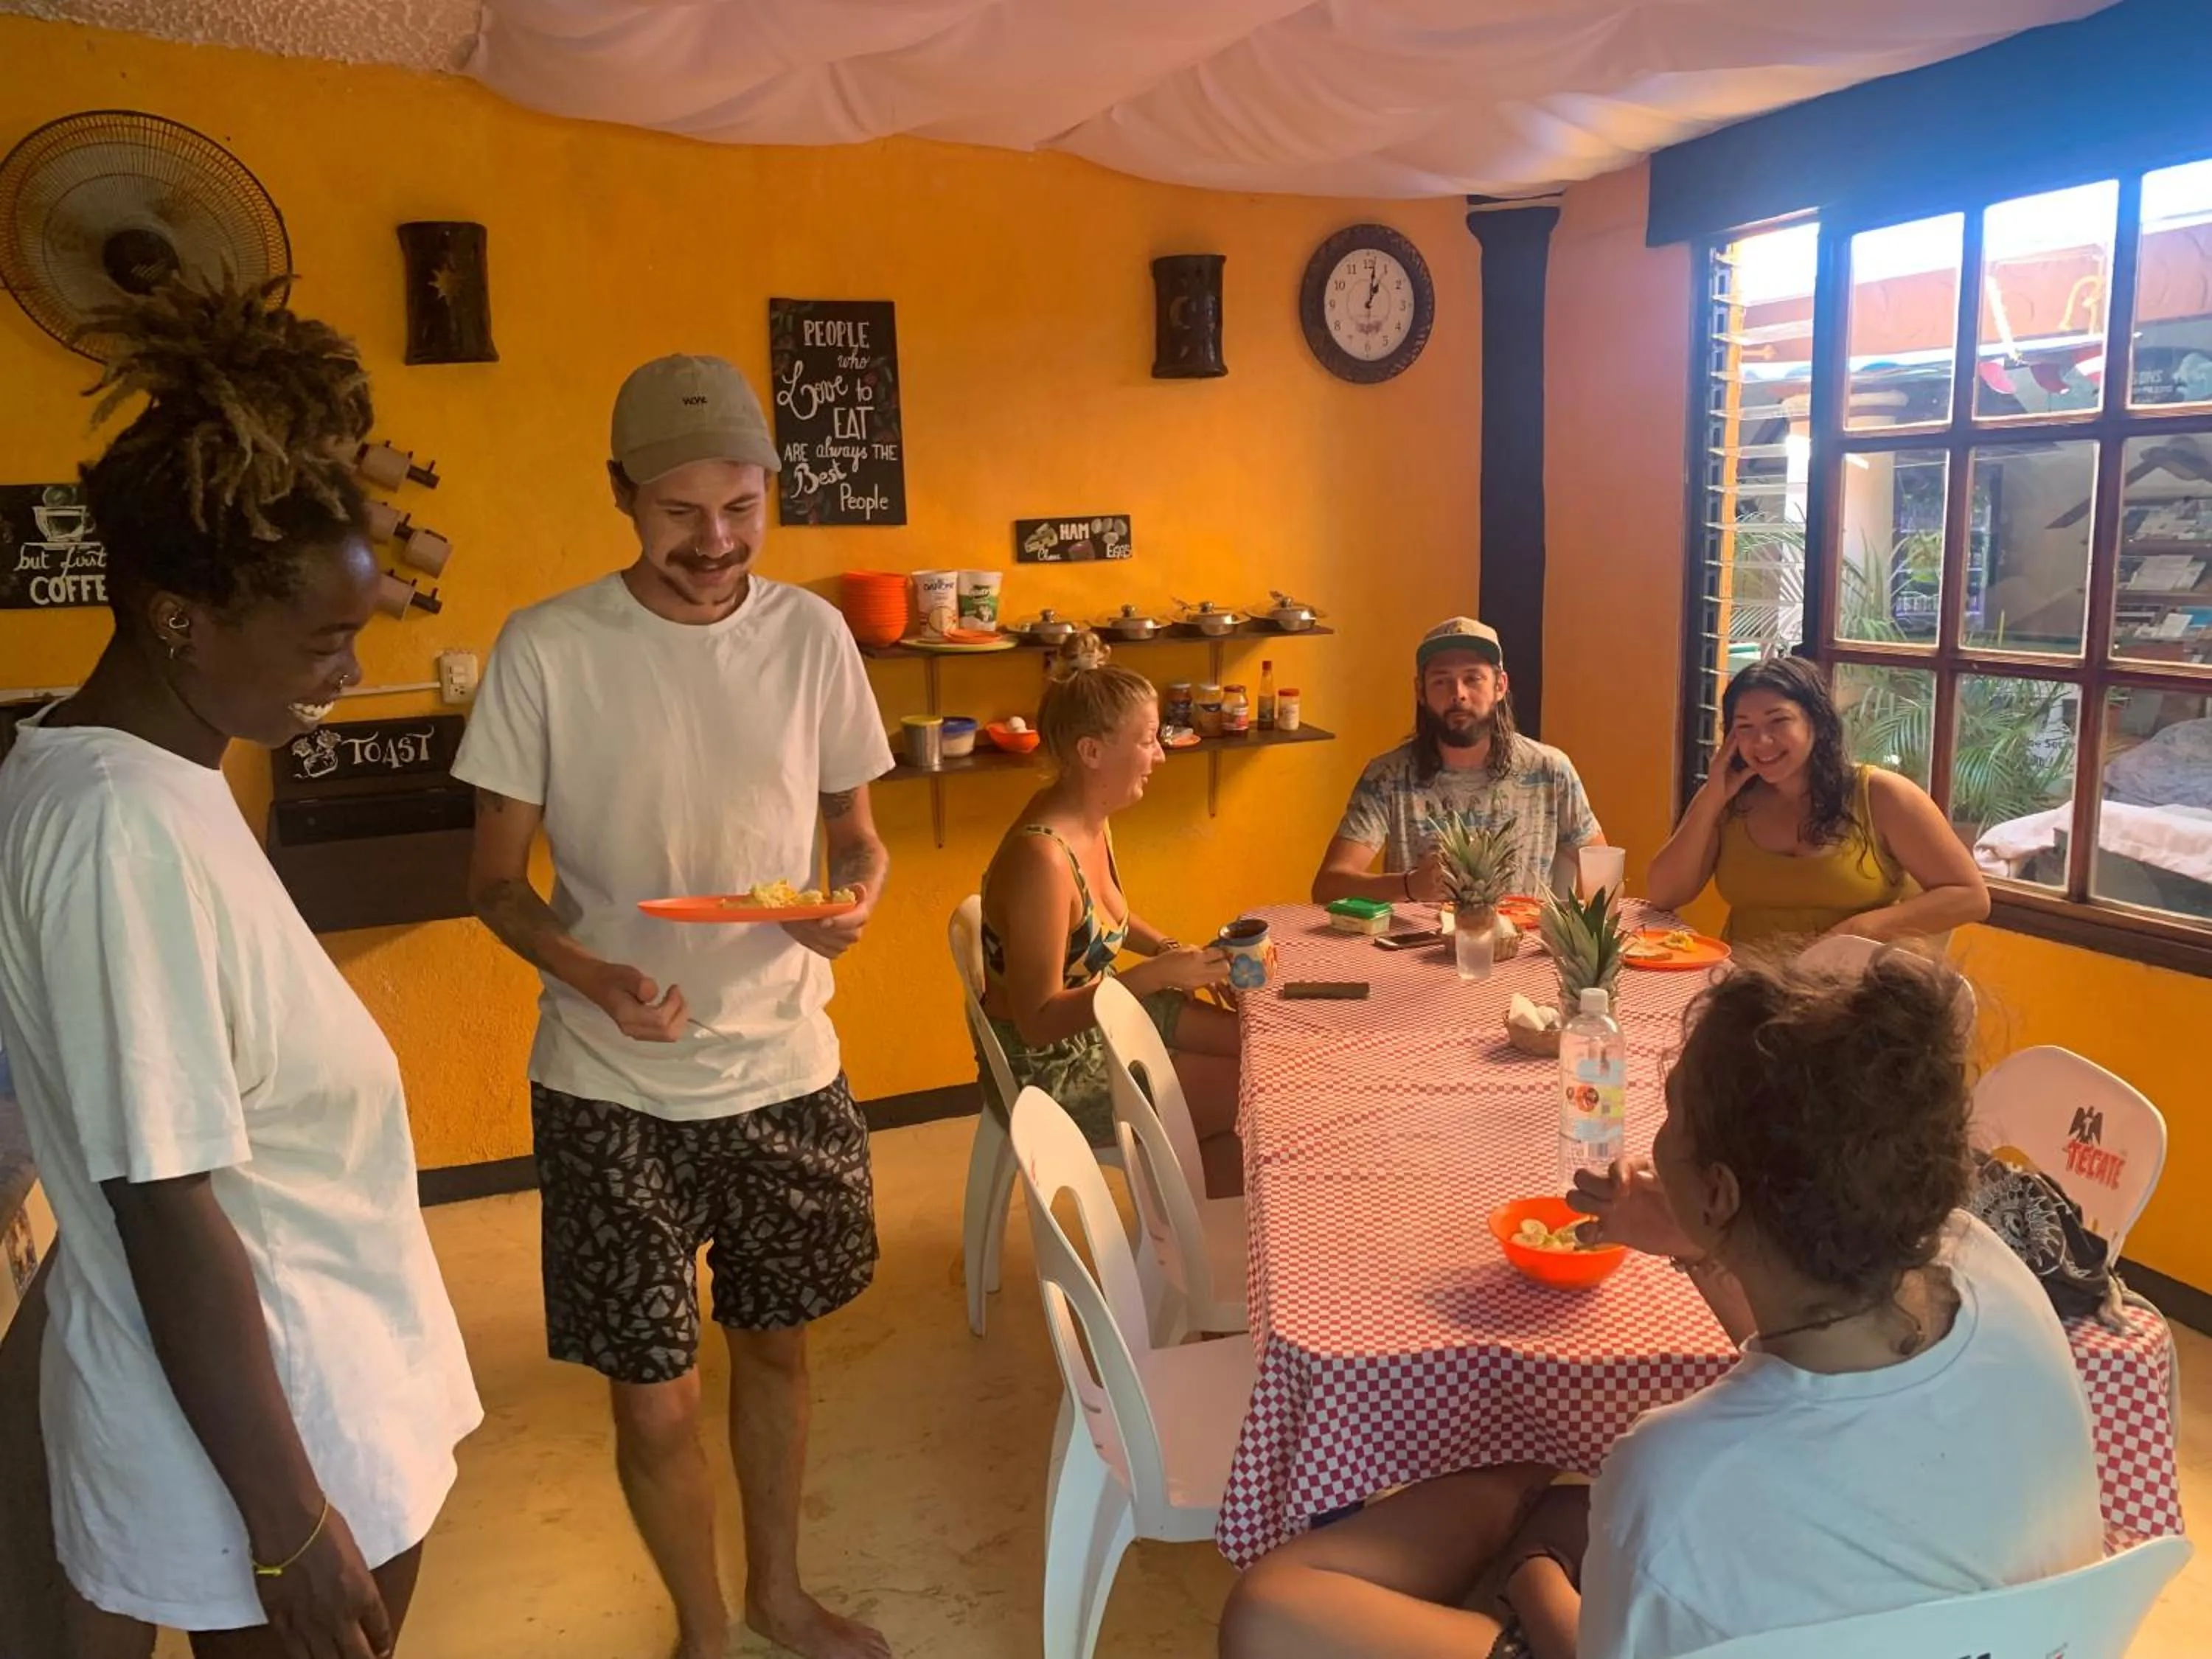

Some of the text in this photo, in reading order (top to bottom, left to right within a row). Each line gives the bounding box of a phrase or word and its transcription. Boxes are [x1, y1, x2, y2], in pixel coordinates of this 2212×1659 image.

[1334, 280, 1346, 291] 10
[804, 320, 870, 348] PEOPLE
[838, 349, 869, 369] who
[776, 360, 873, 420] Love to
[834, 406, 874, 440] EAT
[784, 435, 898, 473] ARE always THE
[790, 459, 846, 499] Best
[840, 484, 889, 521] People
[1060, 522, 1090, 540] HAM
[13, 545, 108, 579] but first
[29, 574, 109, 605] COFFE
[341, 725, 435, 769] TOAST
[2065, 1140, 2126, 1190] TECATE
